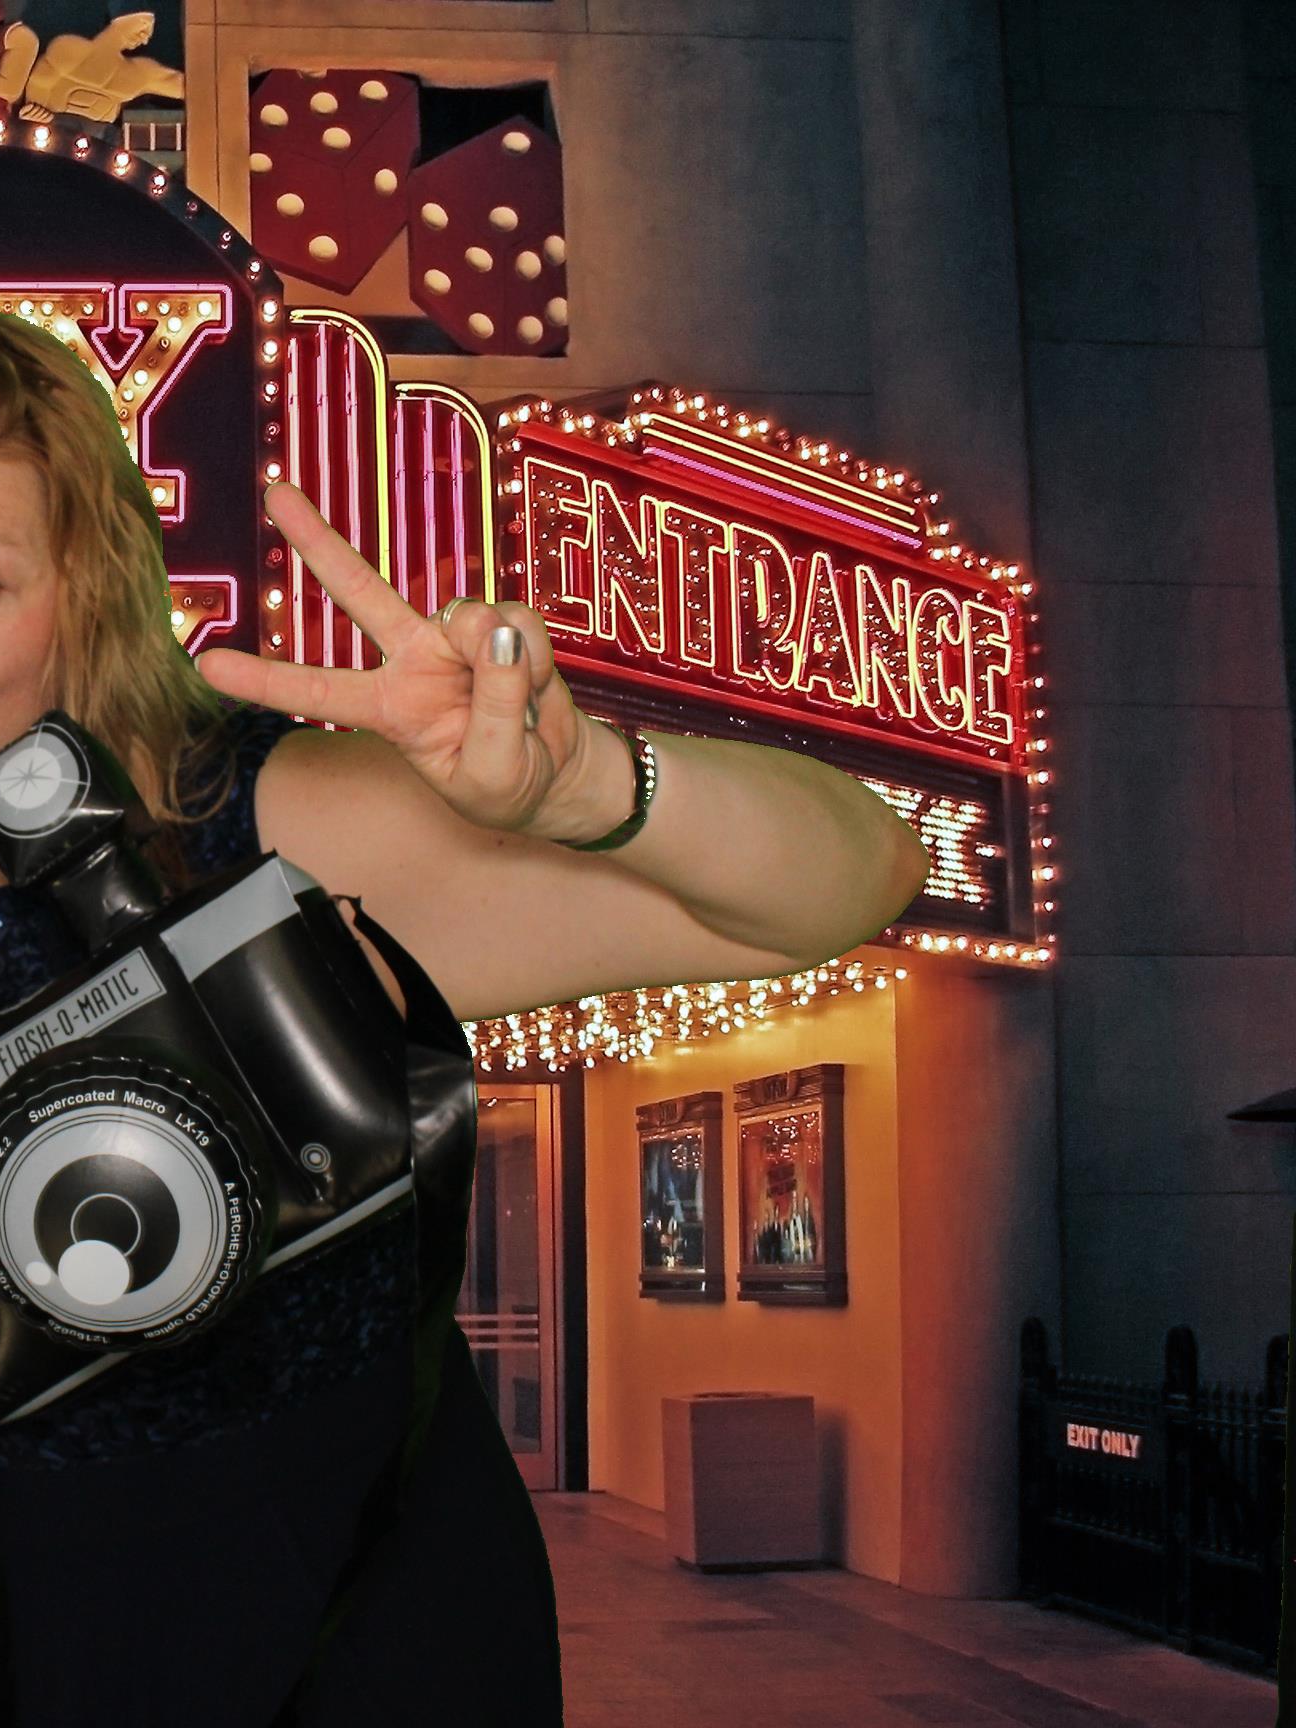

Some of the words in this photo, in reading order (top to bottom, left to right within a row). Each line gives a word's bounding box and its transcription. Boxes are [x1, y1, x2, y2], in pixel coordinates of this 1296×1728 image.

[522, 456, 1014, 745] ENTRANCE
[28, 1089, 116, 1124] Supercoated
[123, 1090, 167, 1115] Macro
[175, 1112, 211, 1147] LX-19
[1066, 1422, 1098, 1450] EXIT
[1101, 1429, 1141, 1459] ONLY
